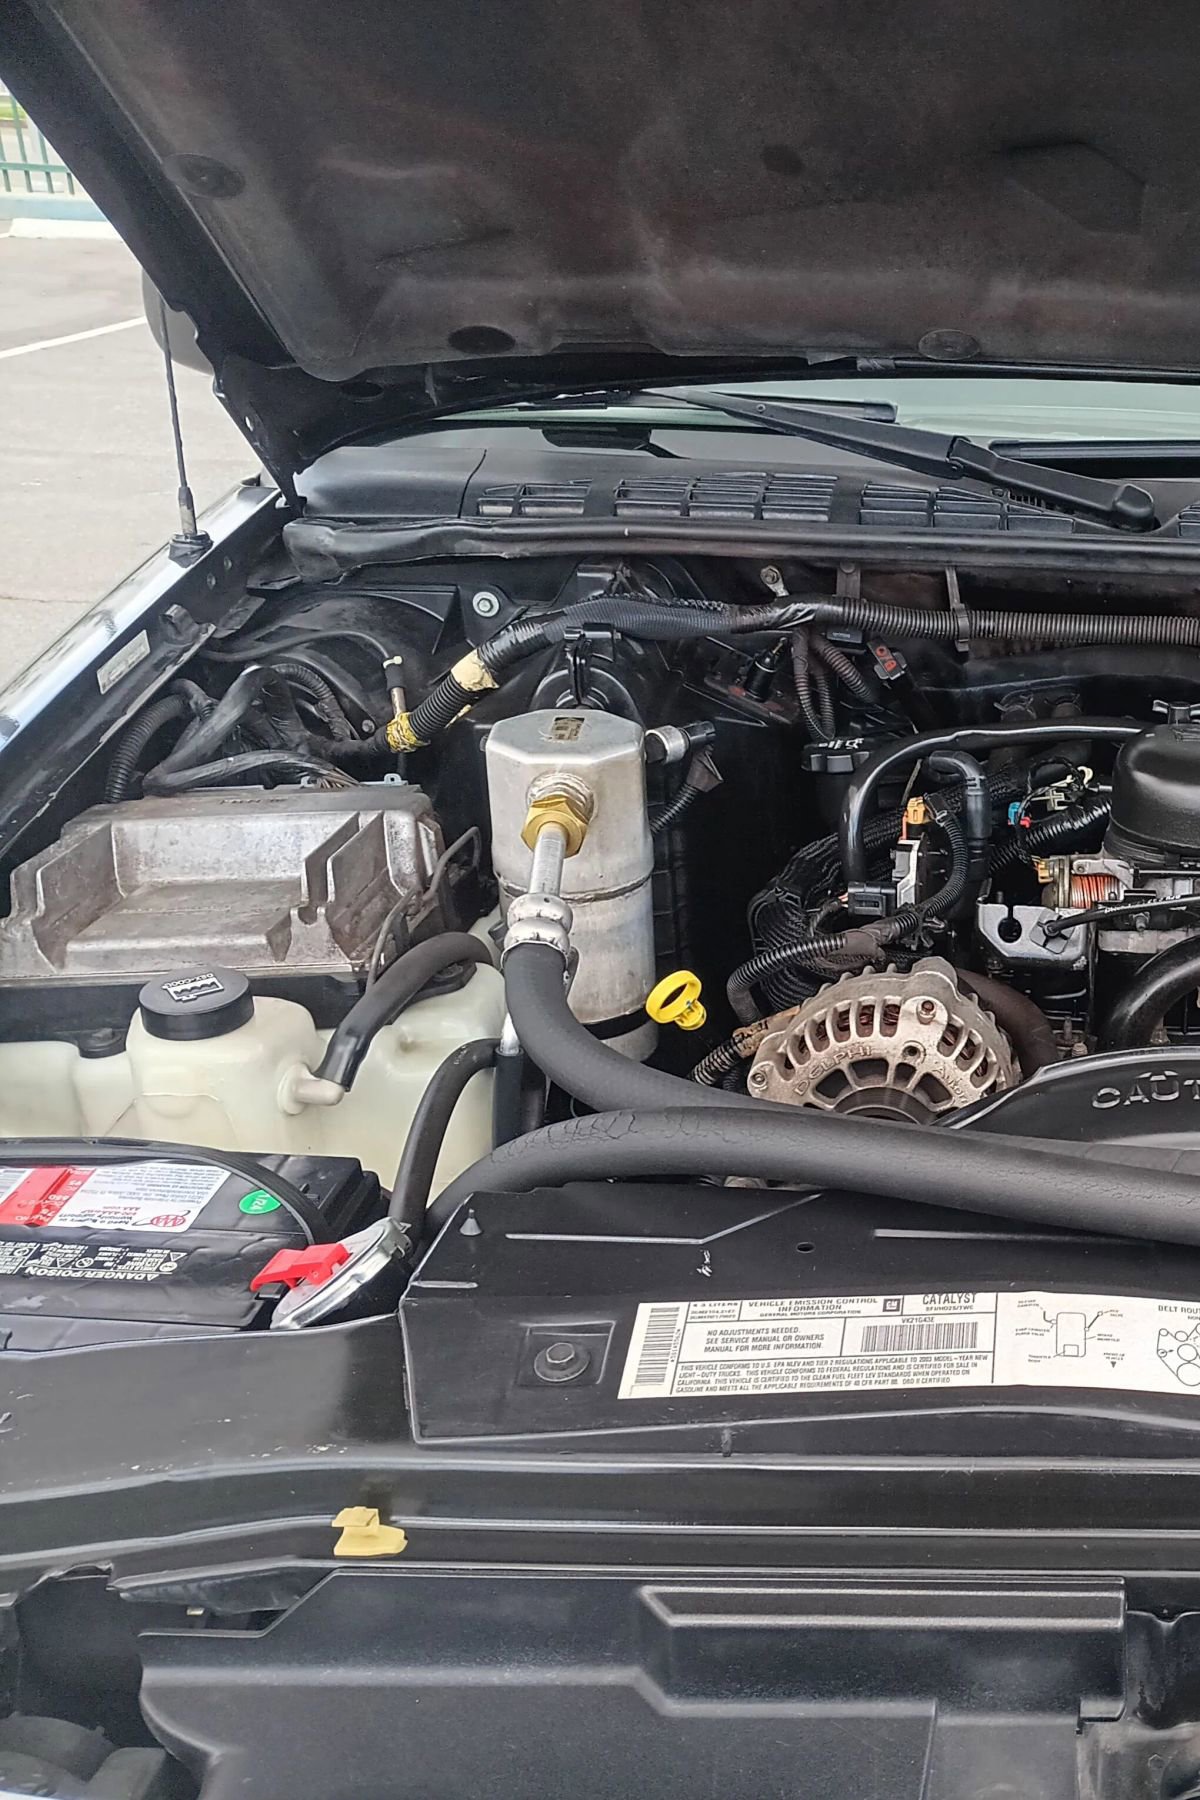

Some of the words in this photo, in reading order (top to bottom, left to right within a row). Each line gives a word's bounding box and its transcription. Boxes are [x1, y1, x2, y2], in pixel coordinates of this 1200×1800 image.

[792, 1045, 873, 1096] DELPHI
[24, 1266, 148, 1281] DANGER/POISON
[922, 1293, 977, 1305] CATALYST
[1158, 1305, 1178, 1313] BELT
[719, 1328, 770, 1336] ADJUSTMENTS
[704, 1345, 733, 1353] MANUAL
[773, 1342, 823, 1350] INFORMATION.
[835, 1358, 874, 1366] REGULATIONS
[760, 1375, 789, 1383] CERTIFIED
